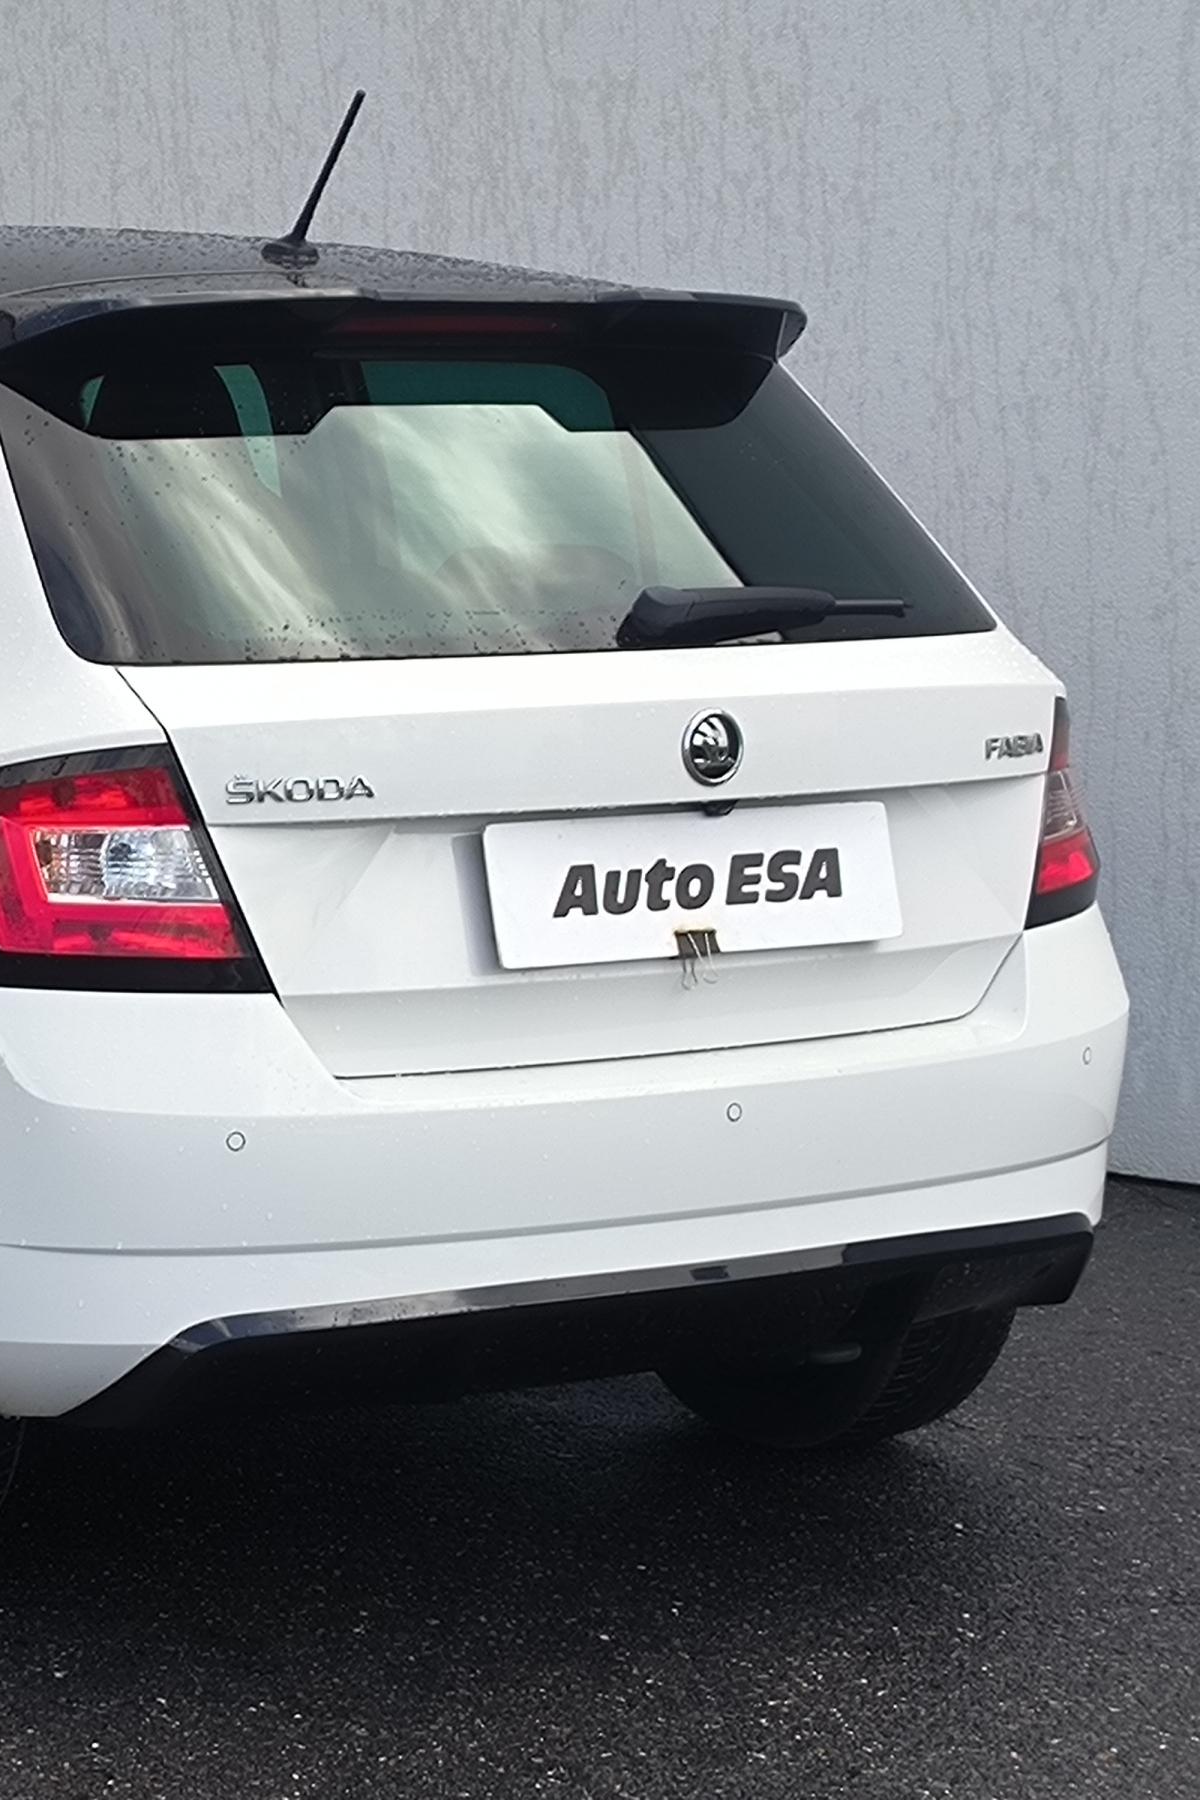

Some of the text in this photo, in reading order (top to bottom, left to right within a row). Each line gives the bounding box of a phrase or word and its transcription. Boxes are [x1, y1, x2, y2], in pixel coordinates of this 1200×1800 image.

[225, 774, 375, 804] ŠKODA
[552, 847, 842, 918] Auto ESA
